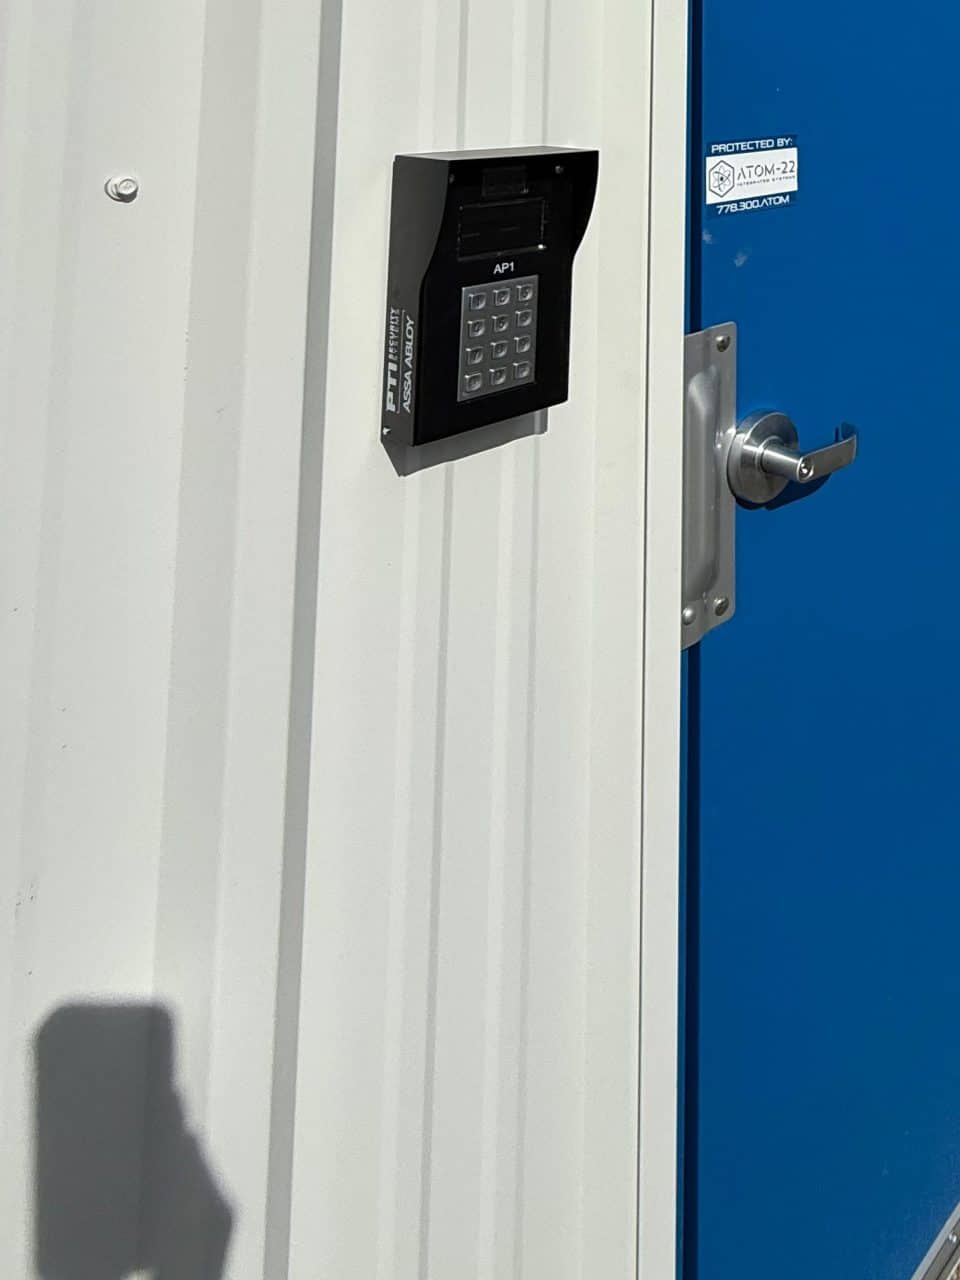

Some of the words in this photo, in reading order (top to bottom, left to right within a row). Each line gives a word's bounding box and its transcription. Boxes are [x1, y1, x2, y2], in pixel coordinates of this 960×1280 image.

[711, 138, 775, 154] PROTECTED
[776, 137, 793, 148] BY:
[737, 160, 796, 181] ATOM-22
[493, 261, 515, 275] AP1
[404, 315, 415, 369] ABLOY
[385, 361, 398, 412] PTI
[403, 370, 413, 414] ASSA
